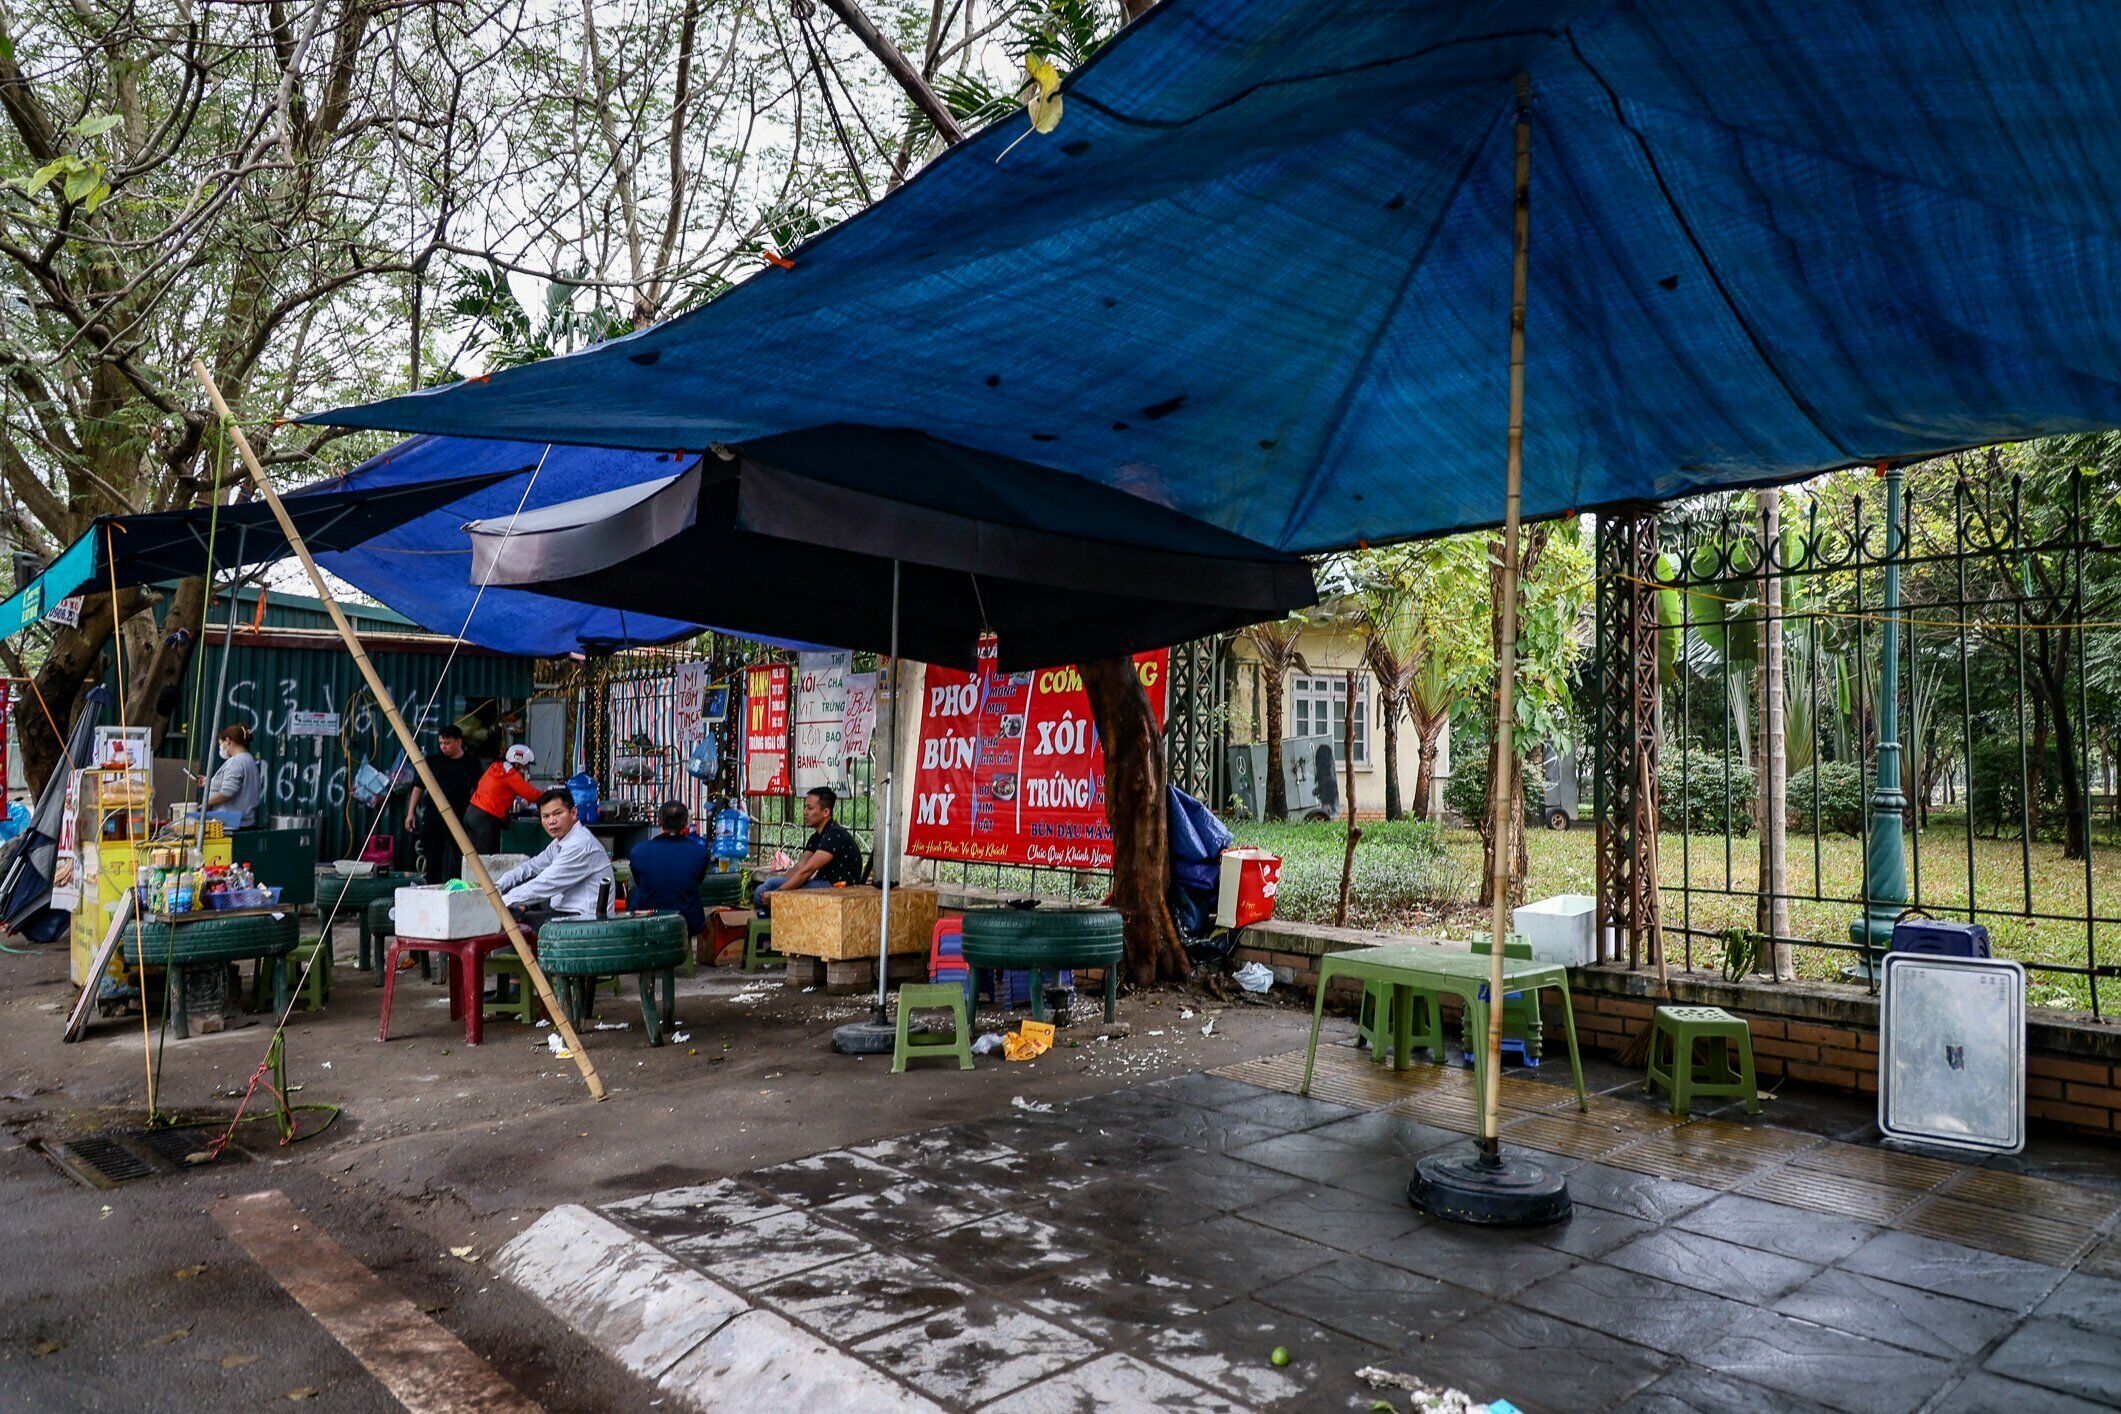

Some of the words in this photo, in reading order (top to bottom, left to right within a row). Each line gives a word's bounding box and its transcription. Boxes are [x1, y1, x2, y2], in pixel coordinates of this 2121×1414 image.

[800, 672, 817, 694] XÔI
[929, 672, 982, 718] PHỞ
[1039, 663, 1084, 695] CƠM
[825, 731, 841, 743] BAO
[1033, 709, 1088, 756] XÔI
[921, 728, 977, 771] BÚN
[1026, 770, 1090, 809] TRỨNG
[916, 785, 956, 827] MỲ
[977, 803, 994, 815] TIM
[1031, 819, 1054, 838] BÚN
[1056, 819, 1083, 842] ĐẬU
[1085, 818, 1114, 840] MẮM
[1027, 844, 1047, 860] Chúc
[1047, 845, 1064, 865] Quý
